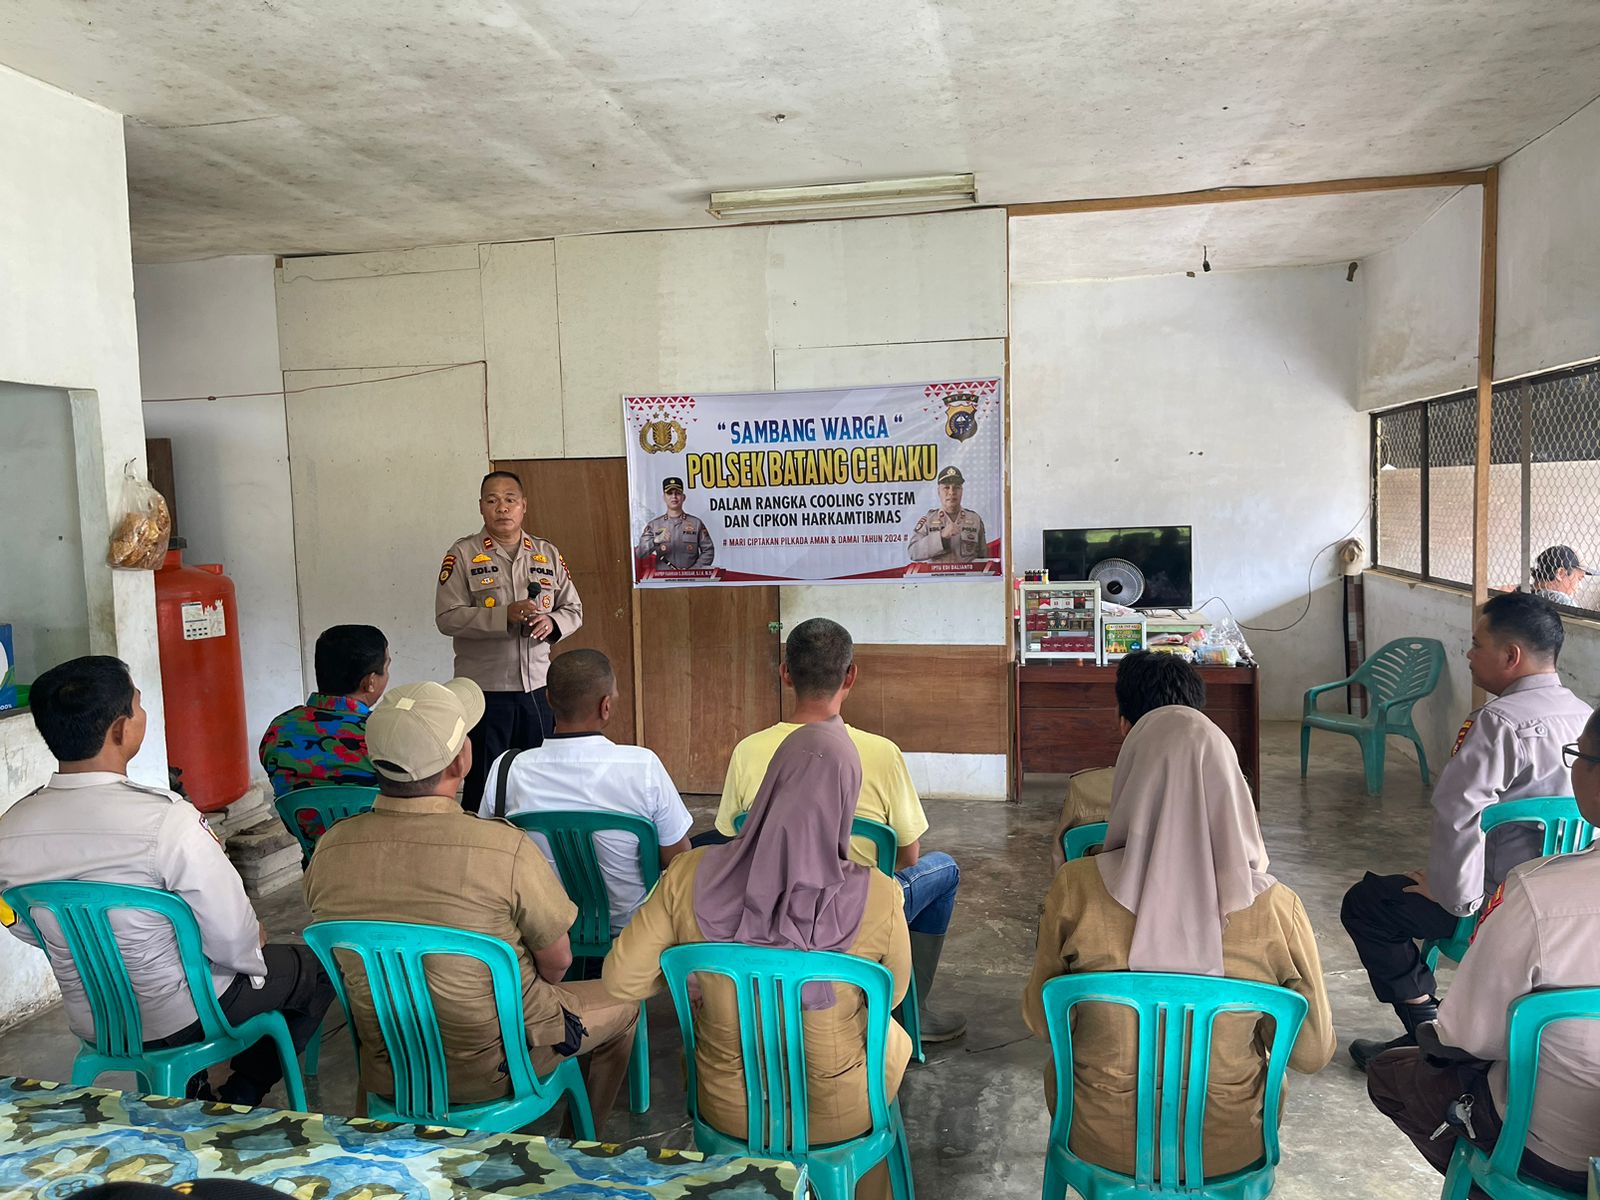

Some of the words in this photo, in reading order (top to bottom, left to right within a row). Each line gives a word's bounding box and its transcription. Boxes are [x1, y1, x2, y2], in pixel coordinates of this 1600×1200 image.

[730, 418, 816, 444] SAMBANG
[821, 415, 889, 441] WARGA
[686, 452, 766, 489] POLSEK
[767, 449, 849, 486] BATANG
[851, 444, 937, 483] CENAKU
[709, 497, 752, 511] DALAM
[756, 495, 807, 510] RANGKA
[810, 493, 864, 508] COOLING
[868, 491, 915, 506] SYSTEM
[724, 514, 750, 528] DAN
[753, 513, 797, 527] CIPKON
[802, 511, 902, 525] HARKAMTIBMAS
[729, 538, 746, 546] MARI
[747, 537, 779, 546] CIPTAKAN
[780, 536, 809, 545] PILKADA
[810, 536, 829, 545] AMAN
[838, 535, 860, 544] DAMAI
[861, 534, 883, 543] TAHUN
[884, 533, 902, 542] 2024
